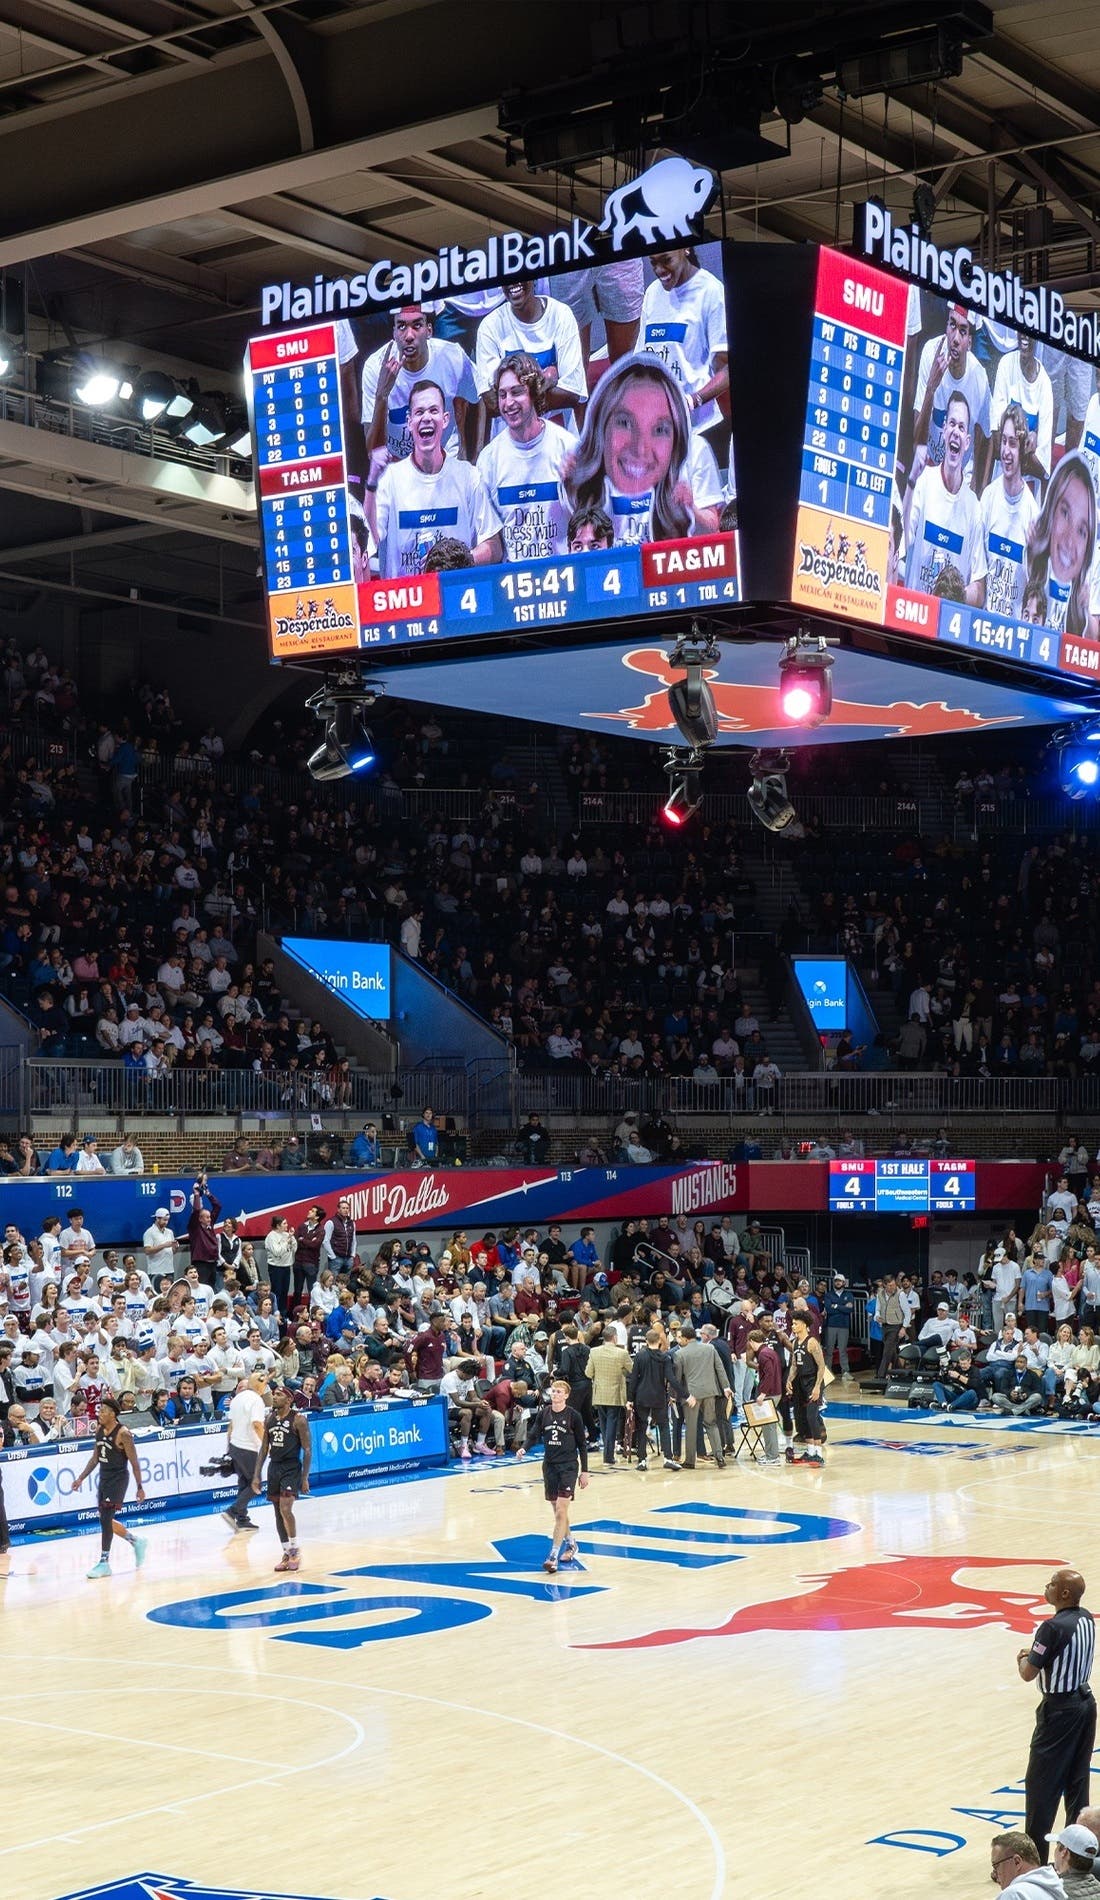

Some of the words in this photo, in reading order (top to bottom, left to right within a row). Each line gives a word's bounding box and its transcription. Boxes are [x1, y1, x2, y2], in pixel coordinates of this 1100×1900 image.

[843, 279, 884, 316] SMU
[276, 339, 308, 358] SMU
[844, 332, 858, 351] PTS
[886, 349, 896, 366] PF
[289, 367, 304, 380] PTS
[317, 362, 327, 374] PF
[823, 346, 830, 361] 1
[845, 354, 853, 370] 2
[867, 363, 875, 378] 0
[886, 370, 893, 385] 0
[267, 387, 273, 399] 1
[294, 382, 302, 394] 2
[319, 377, 327, 389] 0
[821, 367, 828, 383] 2
[843, 376, 851, 391] 0
[866, 384, 873, 399] 0
[884, 391, 891, 406] 0
[268, 403, 275, 415] 2
[295, 398, 302, 410] 0
[321, 393, 328, 405] 0
[819, 388, 827, 404] 3
[842, 396, 849, 412] 0
[864, 405, 871, 420] 0
[882, 412, 890, 427] 0
[269, 419, 276, 431] 3
[296, 414, 304, 425] 0
[322, 409, 329, 421] 0
[814, 409, 828, 427] 12
[840, 418, 847, 433] 0
[862, 426, 869, 441] 0
[881, 432, 888, 448] 0
[267, 434, 281, 446] 12
[297, 429, 305, 441] 0
[323, 425, 330, 437] 0
[268, 449, 282, 462] 22
[299, 445, 306, 457] 0
[324, 441, 331, 452] 0
[812, 430, 826, 447] 22
[838, 439, 846, 454] 0
[861, 447, 867, 462] 1
[879, 453, 886, 468] 0
[281, 467, 322, 486] TA&M
[814, 456, 837, 477] FOULS
[299, 495, 313, 508] PTS
[326, 491, 336, 503] PF
[818, 480, 828, 504] 1
[276, 515, 283, 526] 2
[303, 510, 311, 522] 0
[328, 506, 336, 518] 0
[863, 494, 874, 518] 4
[277, 530, 284, 541] 4
[304, 526, 312, 537] 0
[330, 522, 337, 534] 0
[275, 545, 288, 557] 11
[305, 541, 313, 553] 0
[331, 538, 338, 549] 0
[276, 561, 290, 573] 15
[307, 557, 314, 569] 2
[332, 553, 338, 565] 1
[653, 544, 725, 575] TA&M
[800, 546, 880, 592] Desperados
[277, 576, 291, 588] 23
[308, 573, 315, 585] 2
[333, 569, 340, 580] 0
[500, 566, 575, 600] 15:41
[603, 569, 620, 595] 4
[373, 586, 423, 612] SMU
[460, 588, 477, 614] 4
[649, 592, 667, 607] FLS
[676, 588, 686, 603] 1
[699, 585, 718, 600] TOL
[723, 582, 734, 597] 4
[513, 604, 535, 622] 1ST
[538, 601, 567, 620] HALF
[896, 598, 928, 625] SMU
[276, 612, 353, 637] Desperados
[364, 627, 380, 642] FLS
[388, 625, 396, 639] 1
[407, 622, 424, 637] TOL
[428, 620, 438, 634] 4
[950, 613, 961, 638] 4
[973, 619, 1013, 650] 15:41
[1019, 642, 1025, 658] 1
[1040, 638, 1050, 662] 4
[1065, 644, 1099, 670] TA&M
[560, 1171, 571, 1182] 113
[606, 1170, 617, 1180] 114
[841, 1163, 864, 1171] SMU
[881, 1163, 899, 1174] 1ST
[902, 1163, 925, 1174] HALF
[938, 1163, 967, 1171] TA&M
[56, 1185, 72, 1198] 112
[141, 1183, 156, 1195] 113
[672, 1164, 736, 1214] MUSTANGS
[845, 1177, 860, 1196] 4
[944, 1177, 960, 1196] 4
[372, 1184, 387, 1215] UP
[384, 1174, 450, 1224] Dallas
[960, 1201, 966, 1209] 1
[914, 1217, 927, 1227] EXIT
[273, 1431, 284, 1442] 23
[342, 1430, 384, 1455] Origin
[552, 1430, 558, 1440] 2
[128, 1503, 149, 1512] Medical
[150, 1500, 166, 1509] Center
